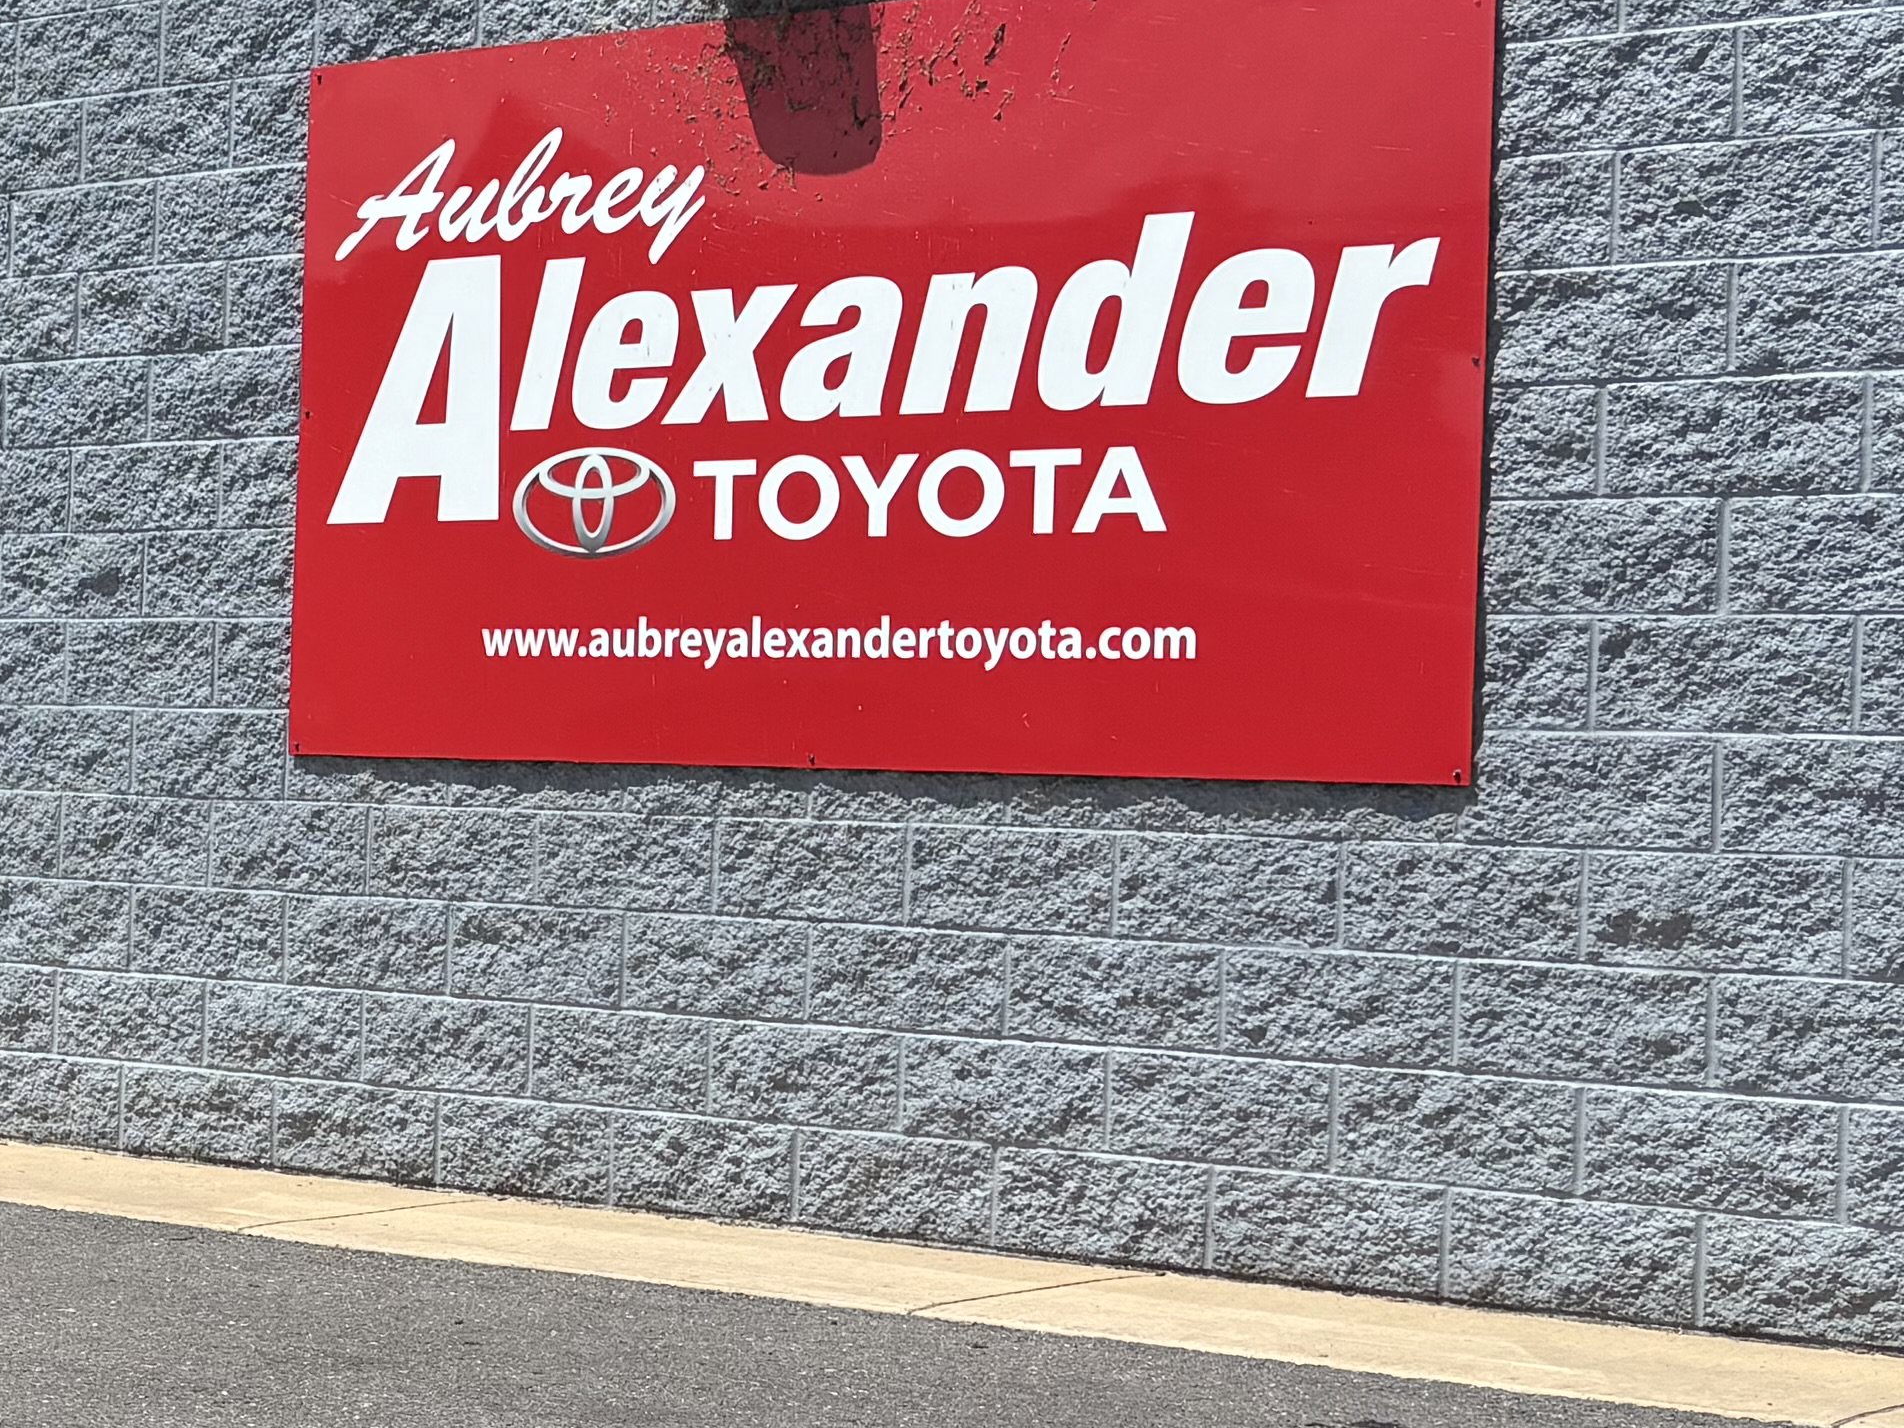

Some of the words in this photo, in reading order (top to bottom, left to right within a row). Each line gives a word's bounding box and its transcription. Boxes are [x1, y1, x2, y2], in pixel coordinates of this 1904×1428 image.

[334, 126, 705, 265] Aubrey
[326, 210, 1441, 525] Alexander
[692, 445, 1168, 541] TOYOTA
[481, 615, 1198, 671] www.aubreyalexandertoyota.com
